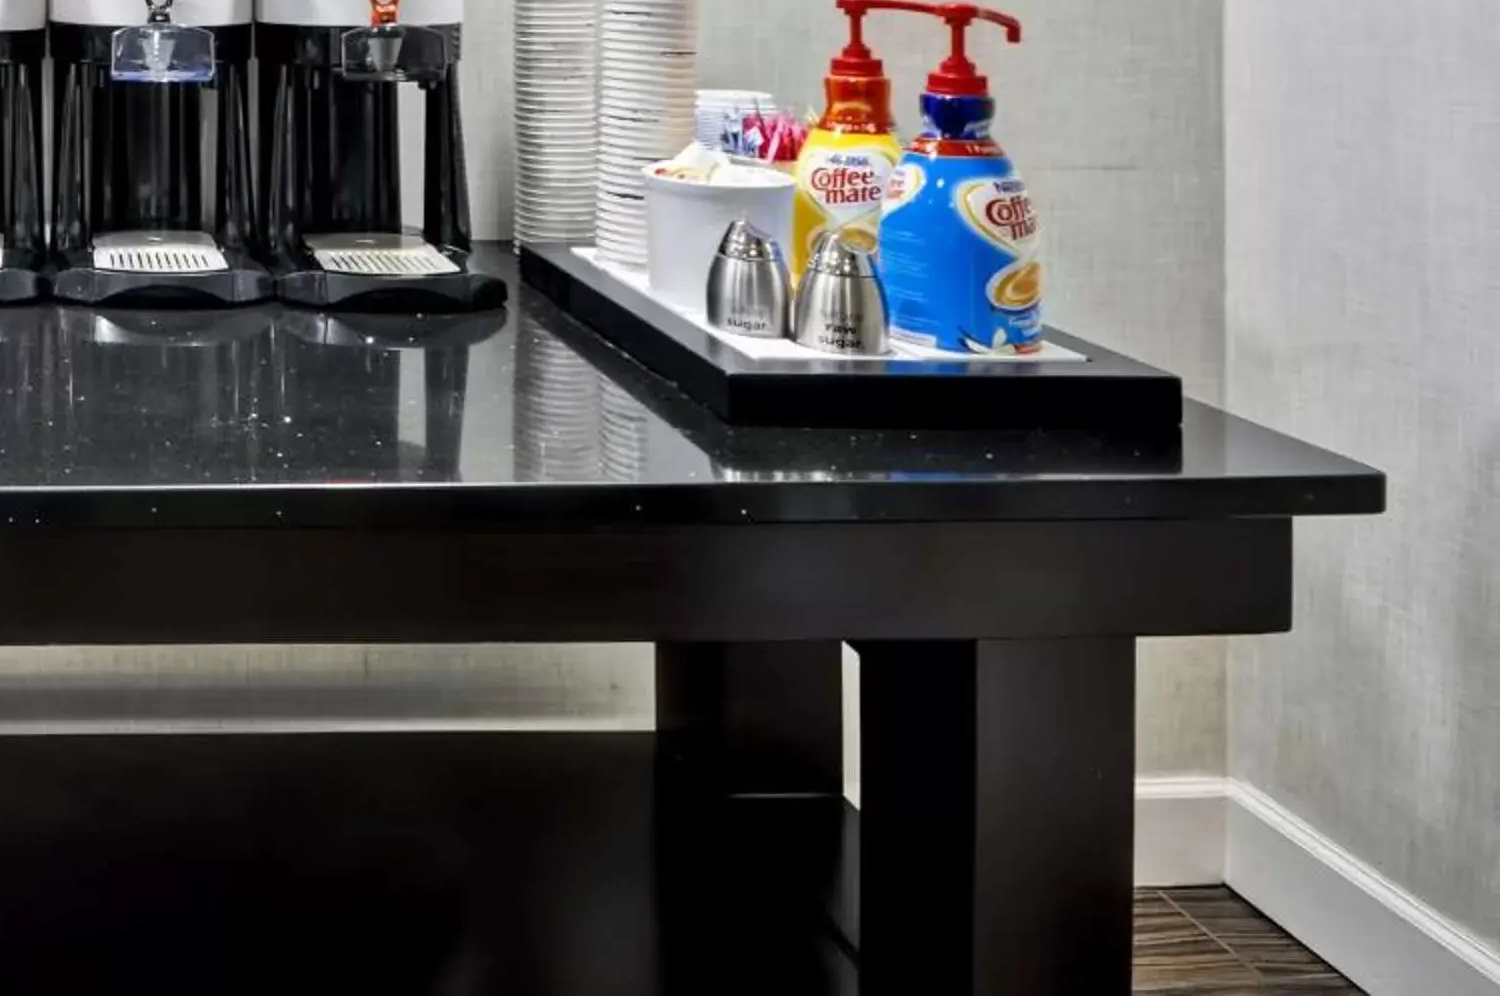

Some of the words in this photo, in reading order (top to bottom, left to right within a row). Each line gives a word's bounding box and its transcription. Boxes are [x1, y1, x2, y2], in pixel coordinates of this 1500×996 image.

[811, 167, 875, 191] Coffee
[825, 185, 882, 204] mate
[825, 323, 858, 334] raw
